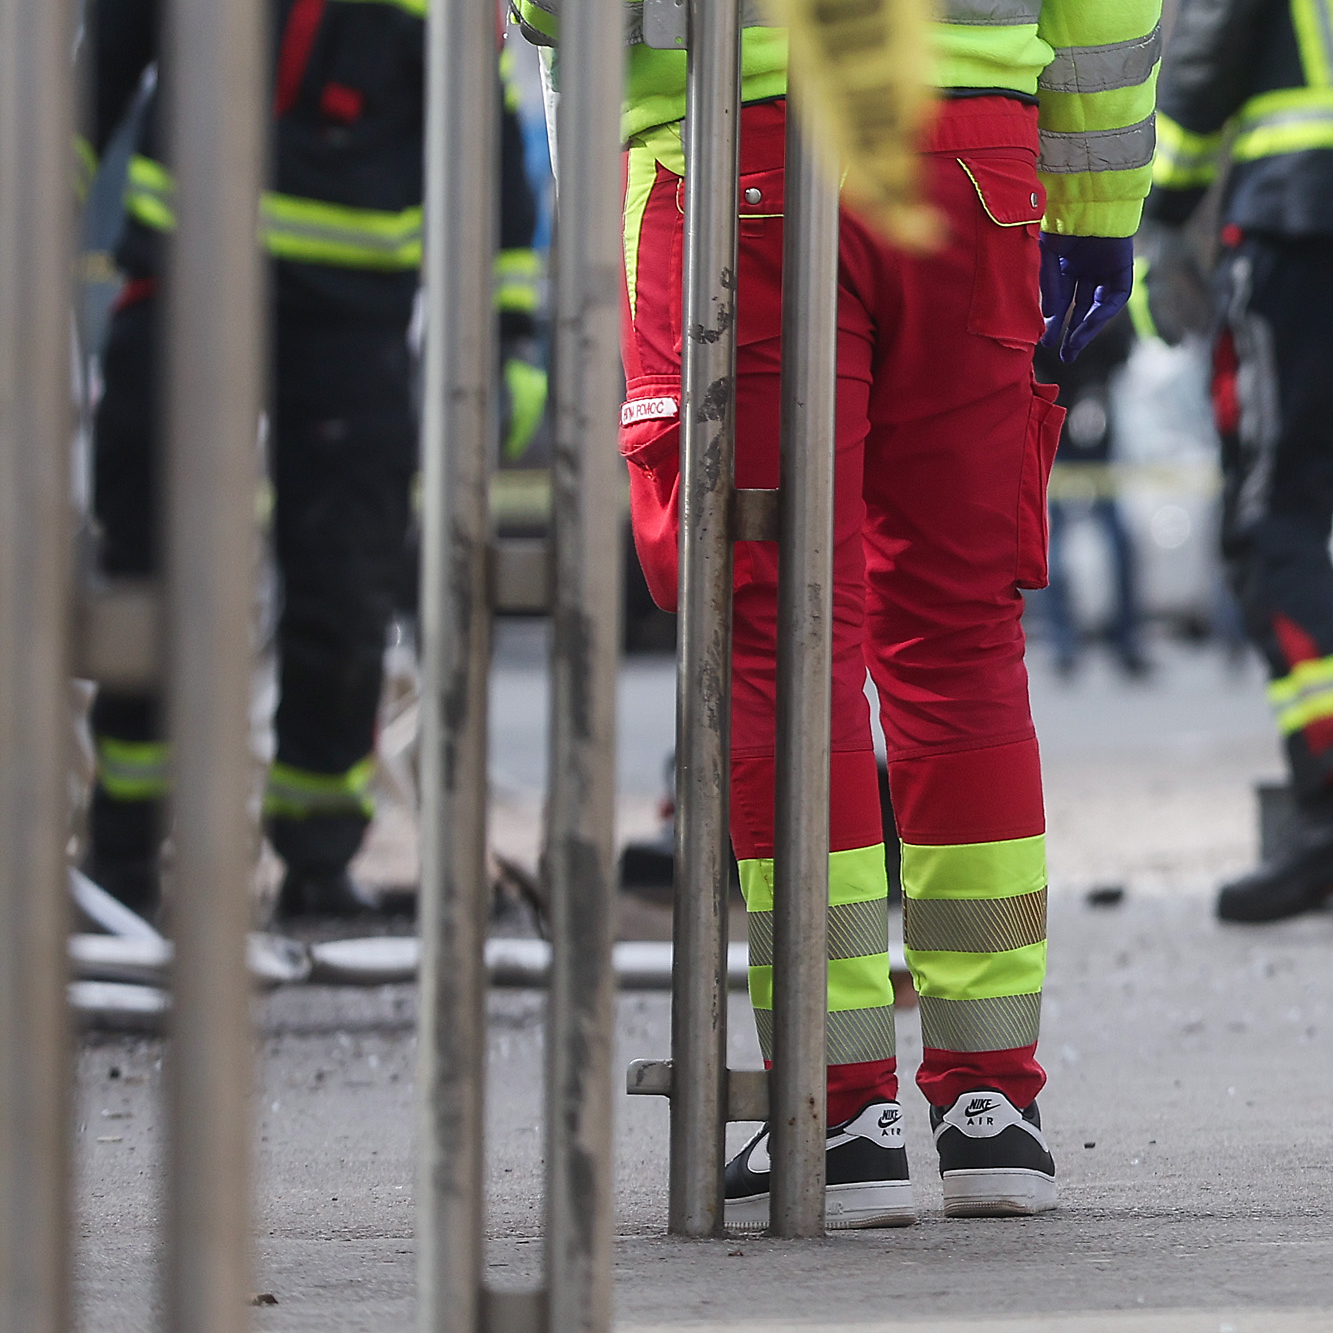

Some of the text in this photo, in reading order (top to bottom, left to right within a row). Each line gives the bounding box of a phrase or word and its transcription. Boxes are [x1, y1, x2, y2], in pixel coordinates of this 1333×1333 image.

[968, 1099, 992, 1110] NIKE
[882, 1109, 900, 1121] NIKE
[967, 1117, 994, 1126] AIR
